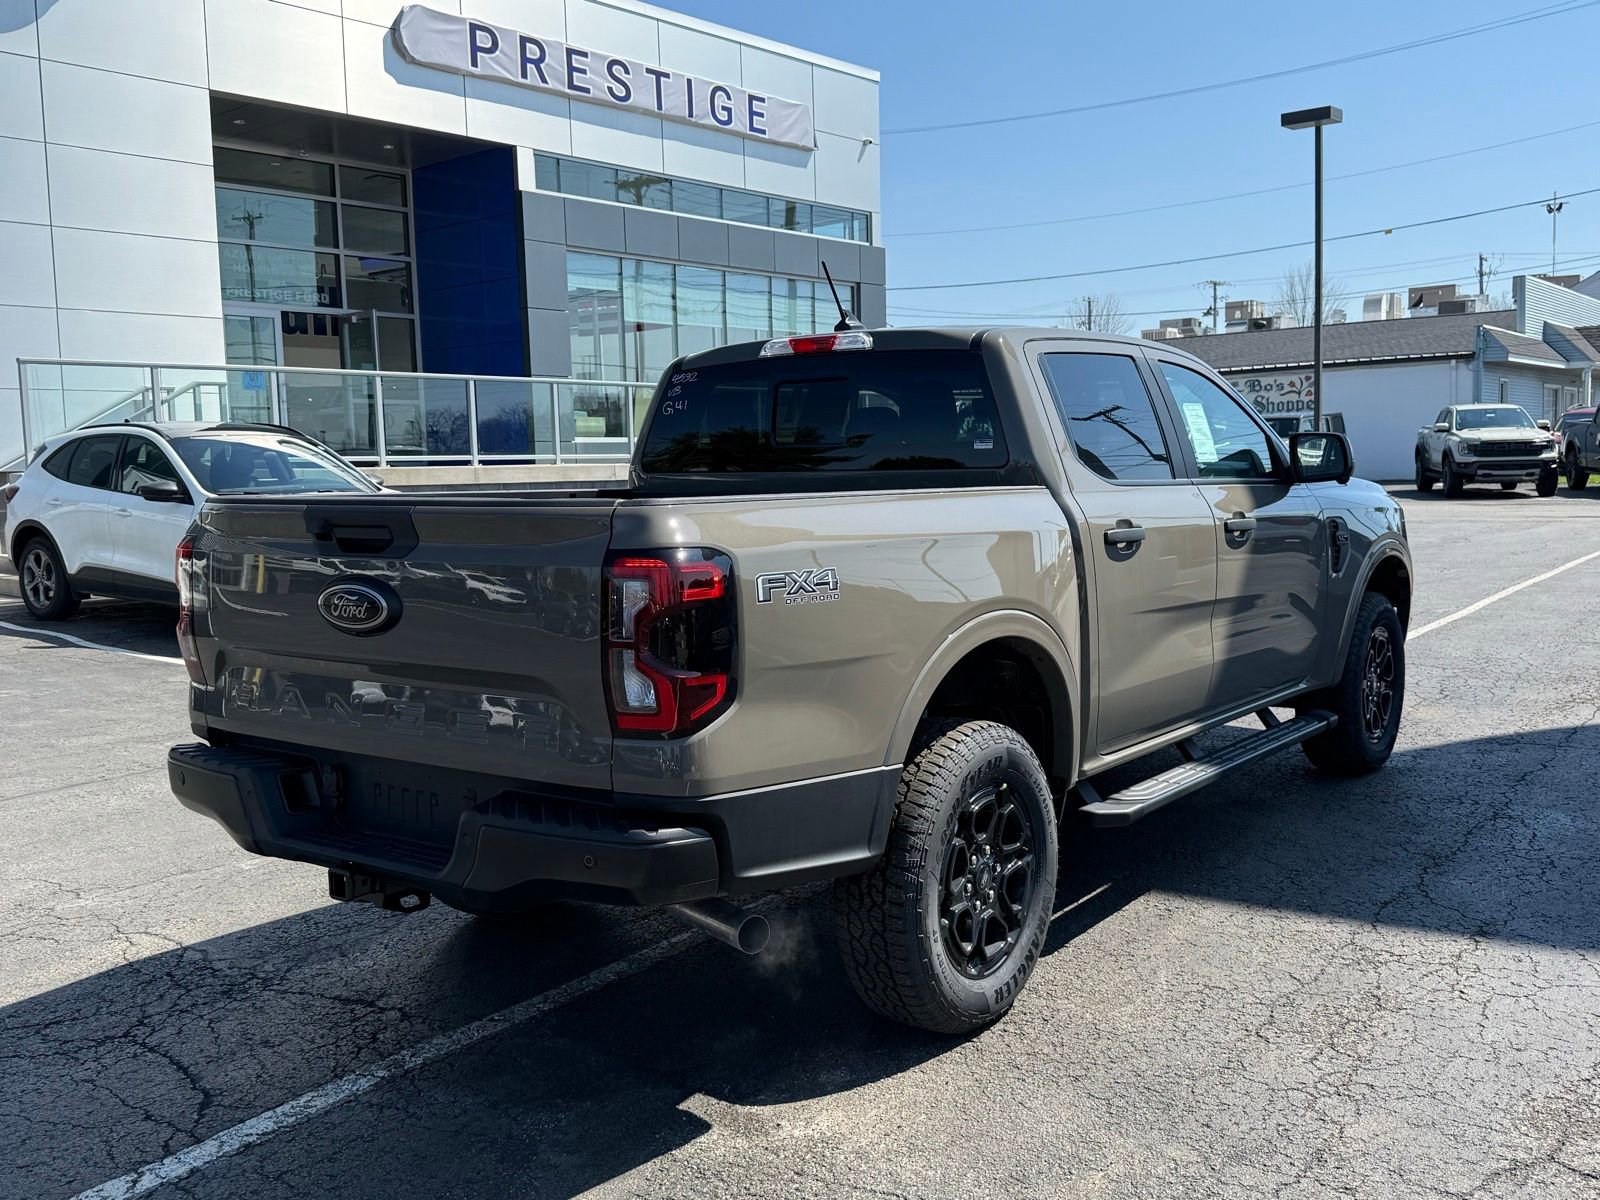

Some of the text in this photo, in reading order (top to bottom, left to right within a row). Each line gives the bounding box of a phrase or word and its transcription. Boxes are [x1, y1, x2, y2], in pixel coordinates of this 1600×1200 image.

[467, 21, 768, 136] PRESTIGE
[225, 287, 329, 303] PRESTIGE FORD
[672, 372, 698, 384] 4532
[1244, 378, 1285, 394] Bo's
[1252, 394, 1315, 413] Shoppe
[755, 567, 840, 604] FX4
[330, 593, 368, 619] Ford
[785, 592, 840, 606] OFF ROAD
[231, 682, 560, 752] RANGER
[935, 755, 1004, 866] GOODYEAR
[993, 894, 1054, 1006] WRANGLER
